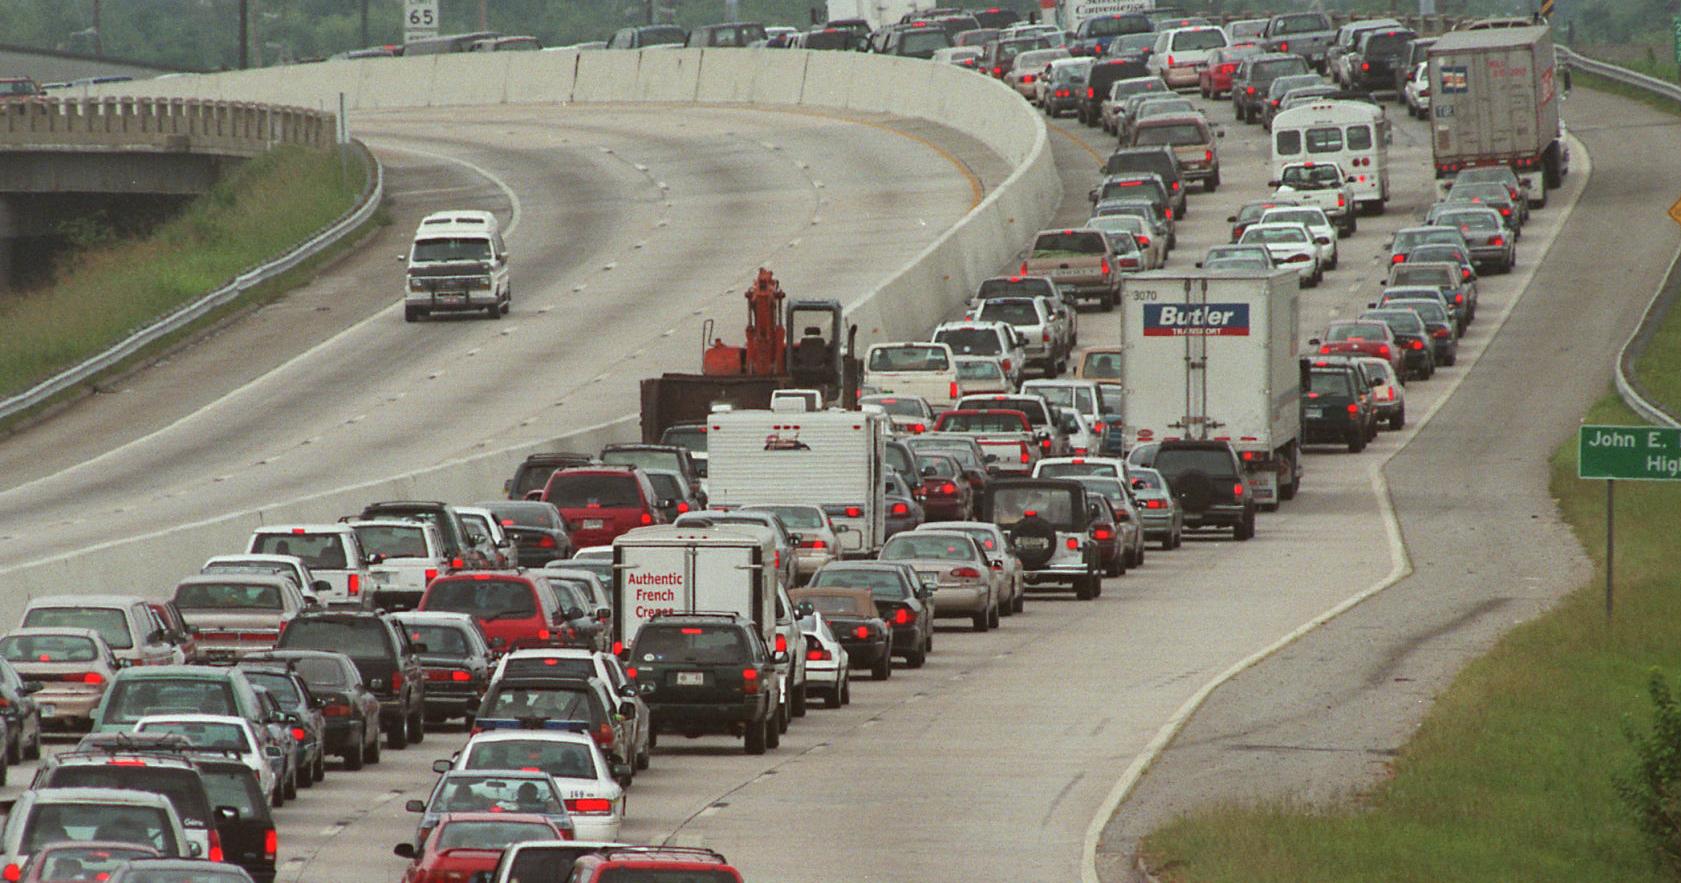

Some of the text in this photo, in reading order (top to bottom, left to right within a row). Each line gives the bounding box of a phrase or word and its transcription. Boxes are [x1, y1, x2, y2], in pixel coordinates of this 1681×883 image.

[410, 9, 433, 25] 65
[1134, 290, 1156, 301] 3070
[1159, 306, 1235, 325] Butler
[1588, 431, 1635, 448] John
[1648, 432, 1667, 448] E.
[1647, 456, 1681, 477] Hig
[628, 572, 683, 585] Authentic
[636, 589, 675, 601] French
